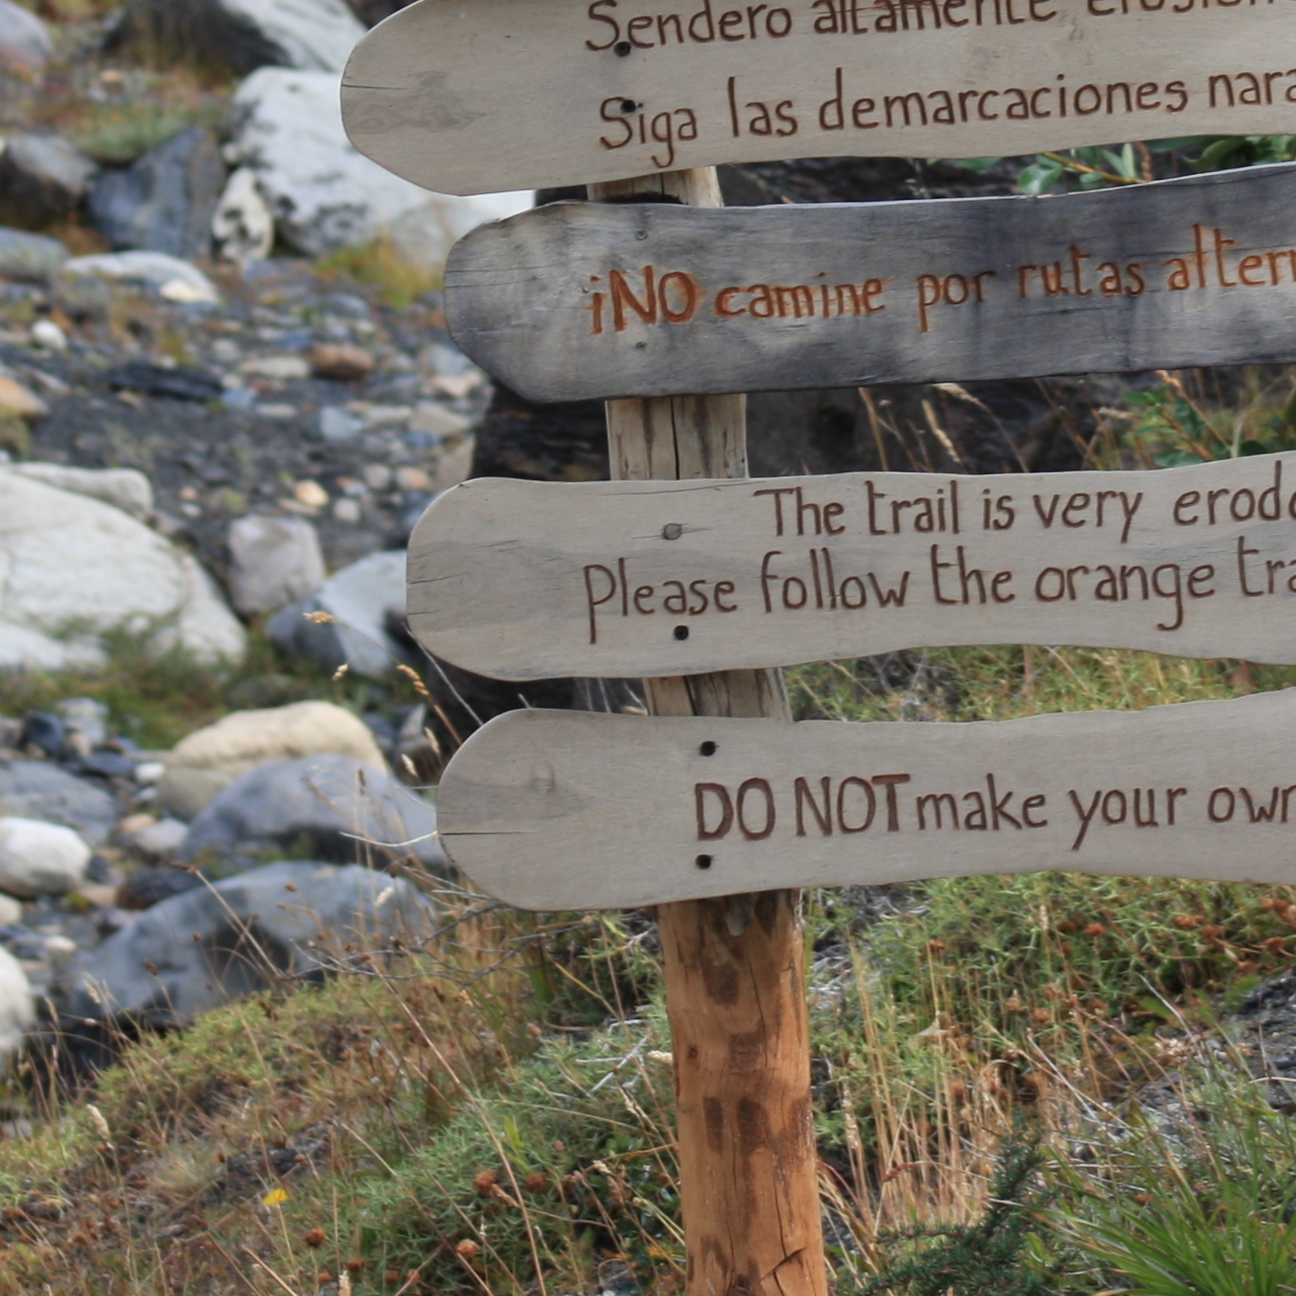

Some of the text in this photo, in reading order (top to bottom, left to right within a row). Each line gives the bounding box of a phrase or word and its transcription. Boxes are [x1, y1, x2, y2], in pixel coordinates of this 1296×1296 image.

[600, 96, 698, 168] Siga
[727, 76, 798, 137] las
[819, 67, 1188, 130] demarcaciones
[713, 272, 888, 320] camine
[917, 267, 996, 332] por
[1017, 245, 1145, 299] rutas
[753, 487, 845, 538] The
[865, 479, 961, 536] trail
[983, 489, 1014, 531] is
[1033, 489, 1142, 543] very
[582, 558, 738, 645] Please
[760, 547, 910, 614] follow
[931, 544, 1015, 605] the
[1035, 559, 1215, 631] orange
[694, 777, 776, 841] DO
[794, 773, 910, 837] NOT
[916, 773, 1048, 833] make
[1069, 785, 1187, 851] your
